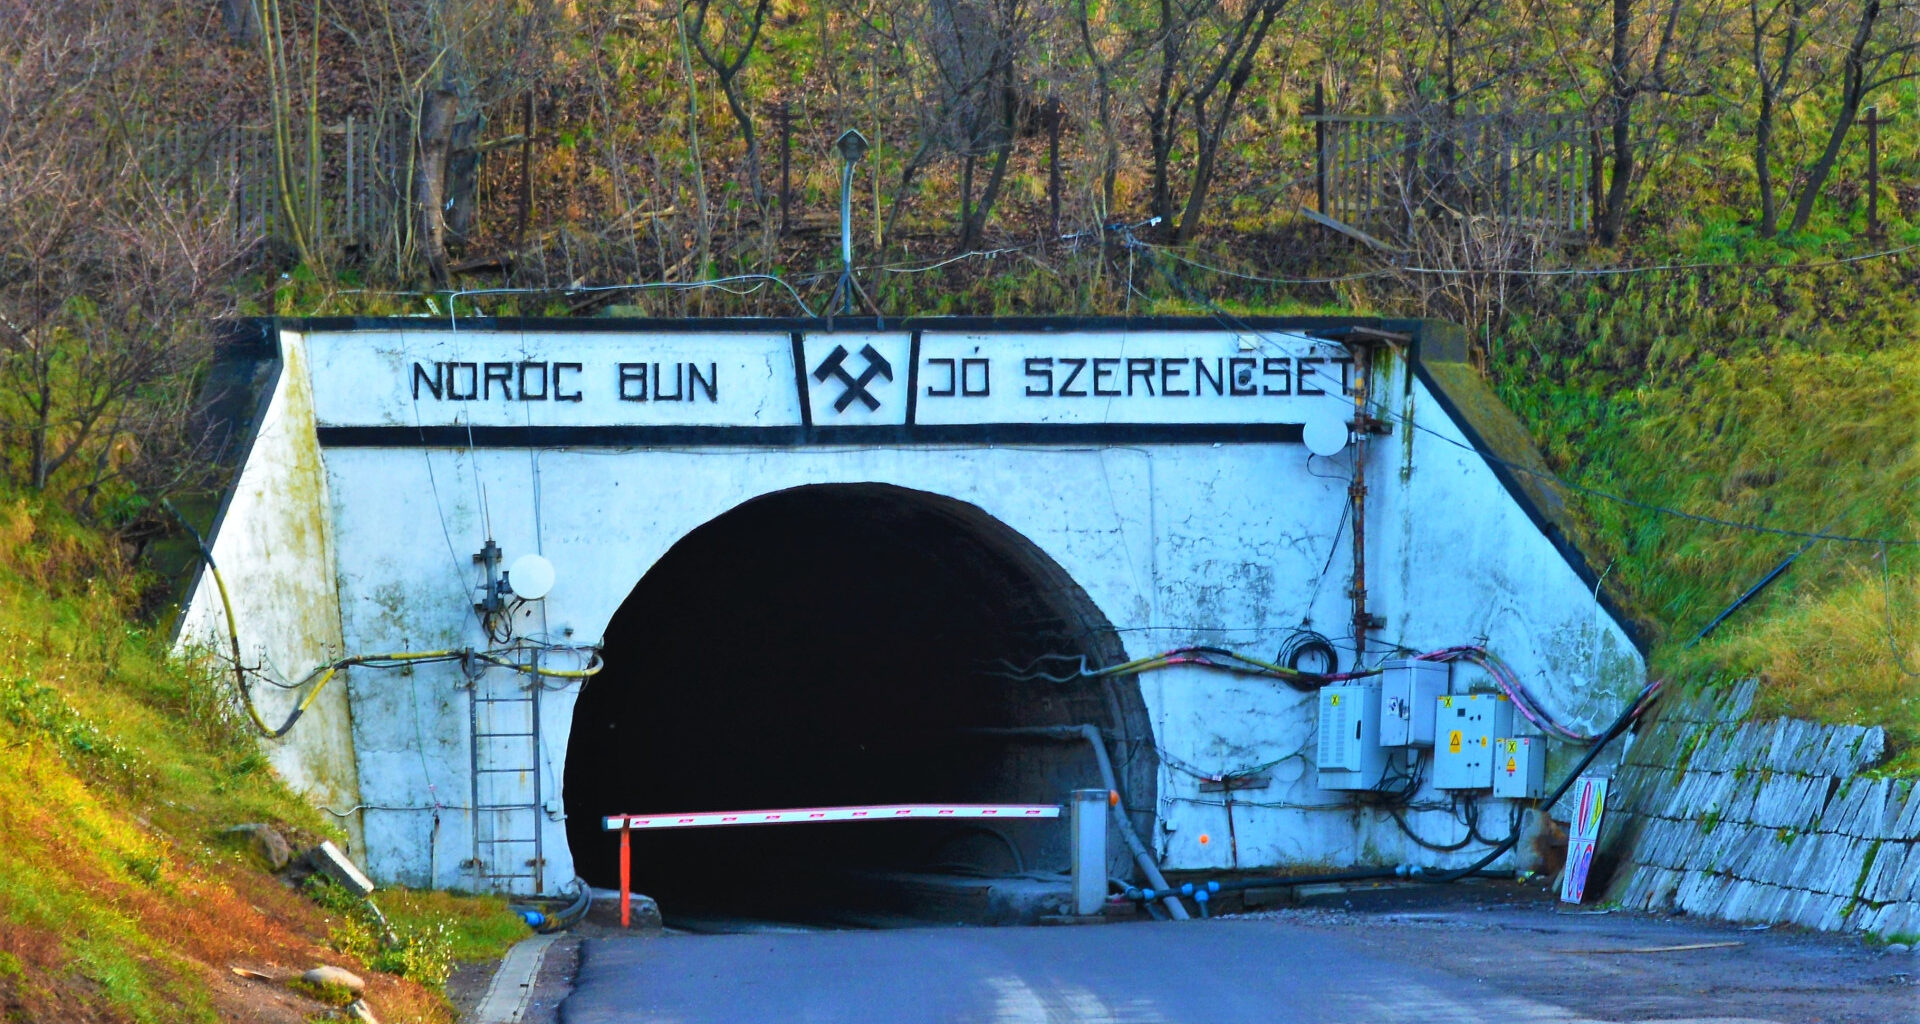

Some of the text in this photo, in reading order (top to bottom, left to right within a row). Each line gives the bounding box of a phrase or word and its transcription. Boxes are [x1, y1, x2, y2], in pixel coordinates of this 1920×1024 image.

[413, 361, 718, 403] NOROC BUN
[927, 346, 990, 397] JÓ
